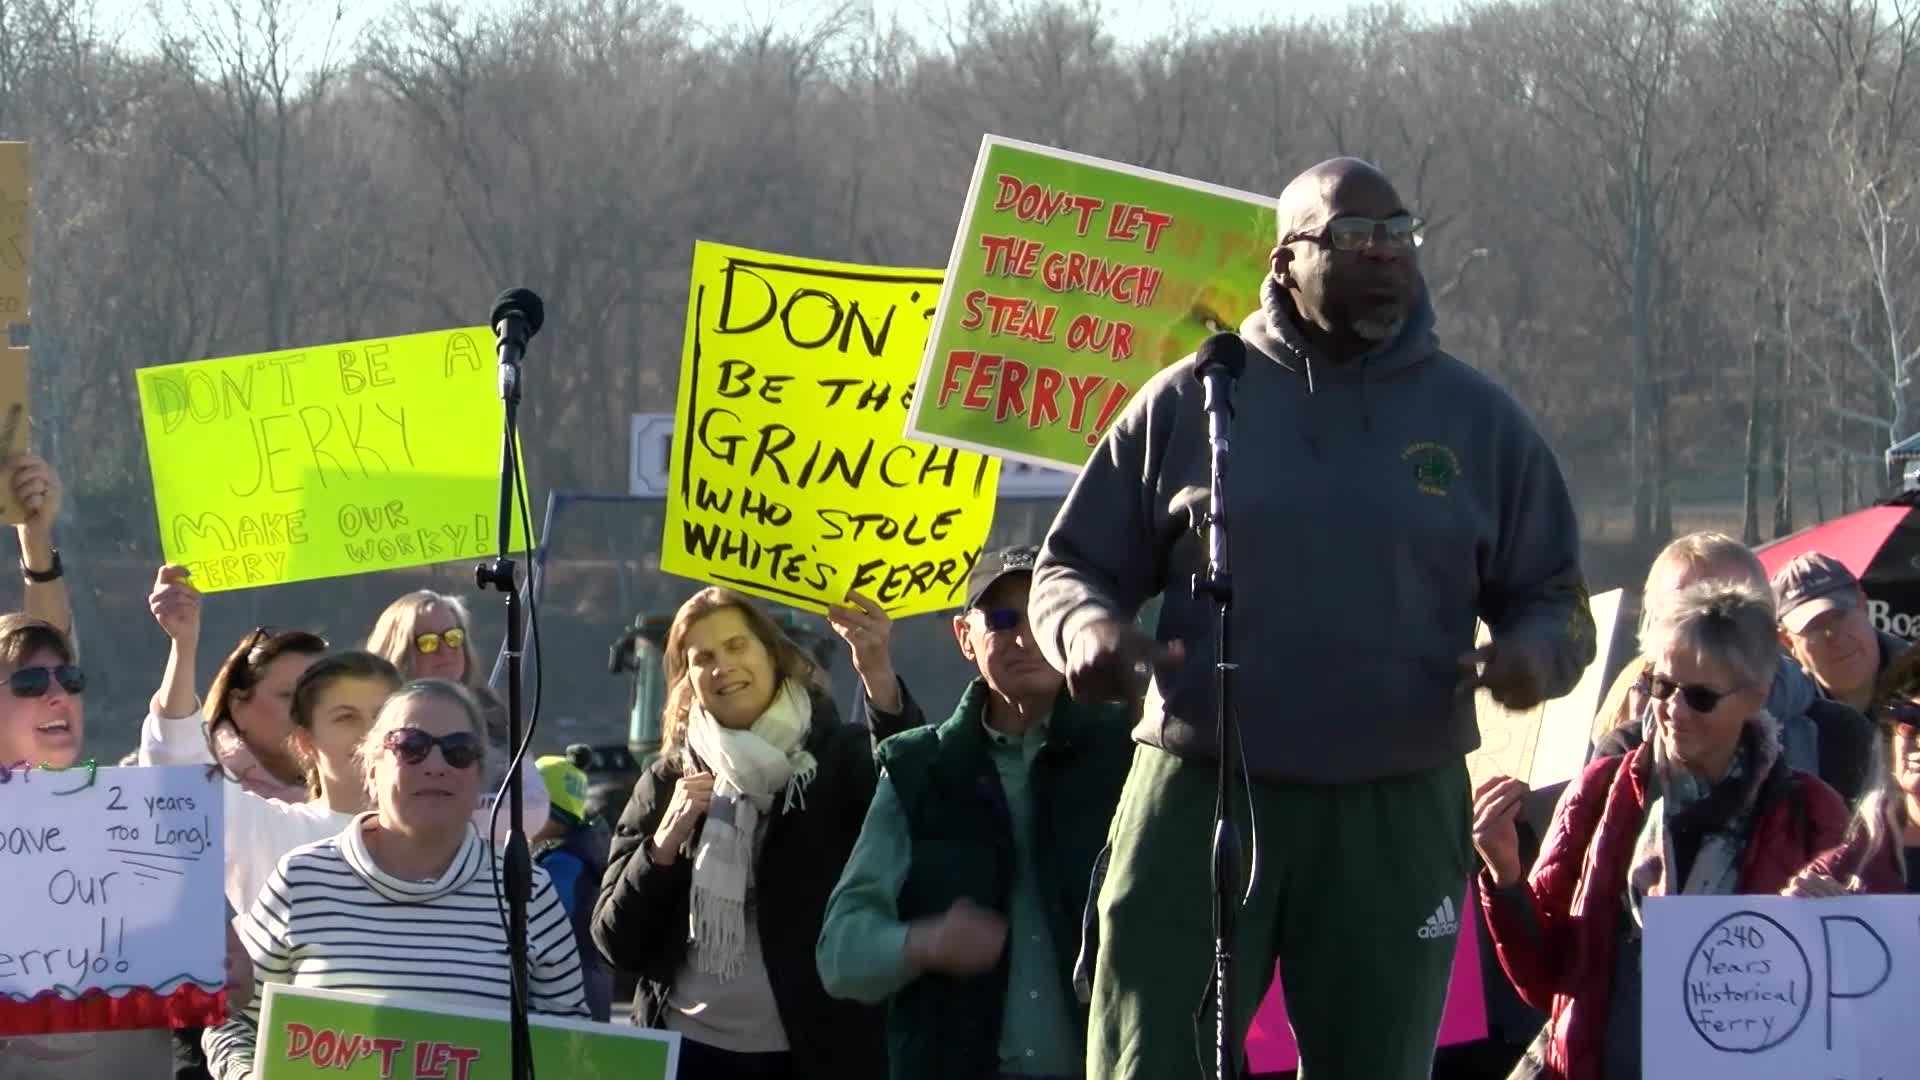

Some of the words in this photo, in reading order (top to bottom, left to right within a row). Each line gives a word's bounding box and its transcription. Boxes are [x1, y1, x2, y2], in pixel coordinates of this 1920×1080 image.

[993, 175, 1104, 237] DON'T
[1106, 203, 1173, 255] LET
[980, 234, 1044, 278] THE
[1042, 251, 1164, 307] GRINCH
[713, 262, 935, 357] DON'
[960, 290, 1060, 343] STEAL
[1065, 313, 1136, 361] OUR
[153, 352, 306, 434] DON'T
[338, 343, 396, 395] BE
[444, 332, 483, 379] A
[717, 360, 795, 403] BE
[936, 350, 1131, 447] FERRY!
[229, 402, 416, 498] JERKY
[699, 408, 957, 489] GRINCH
[172, 510, 310, 553] MAKE
[338, 500, 409, 538] OUR
[696, 480, 792, 527] WHO
[817, 509, 962, 545] STOLE
[186, 551, 286, 588] FERRY
[345, 514, 489, 562] WORKY!
[683, 520, 837, 590] WHITE'S
[847, 546, 982, 602] FERRY
[106, 786, 128, 810] 2
[144, 797, 195, 817] years
[155, 816, 212, 854] Long!
[49, 869, 119, 905] Our
[1702, 948, 1772, 976] Years
[1716, 925, 1765, 949] 240
[1691, 980, 1797, 1006] Historical
[287, 1023, 406, 1078] DON'T
[414, 1041, 480, 1080] LET
